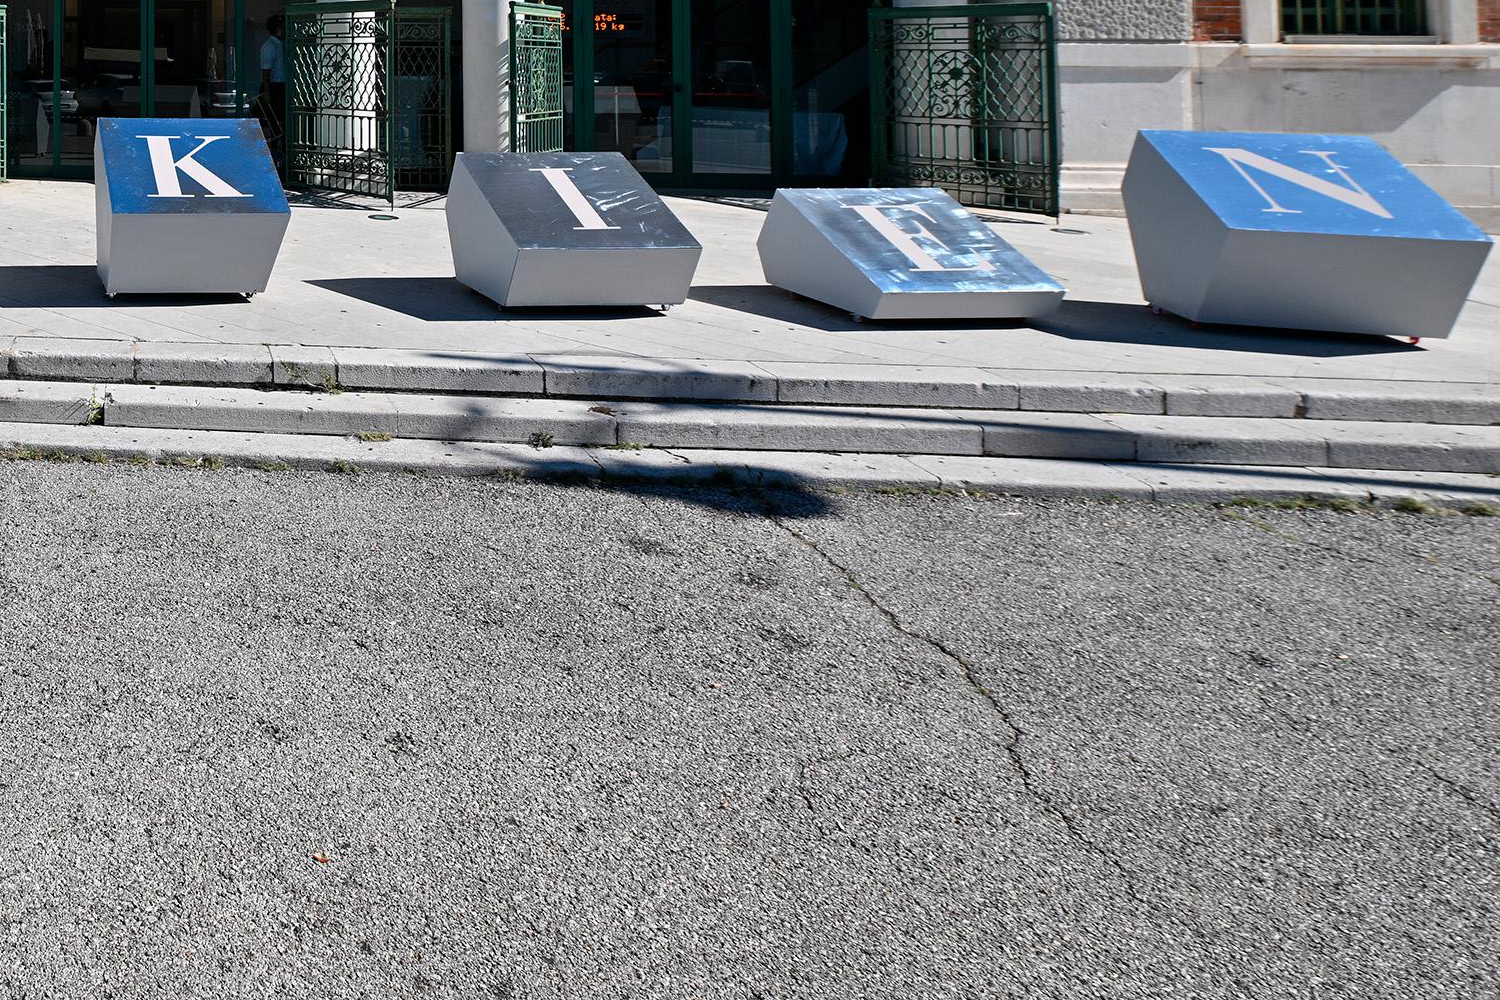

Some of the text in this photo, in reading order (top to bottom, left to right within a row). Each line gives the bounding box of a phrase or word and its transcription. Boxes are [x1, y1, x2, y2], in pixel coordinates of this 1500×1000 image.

[136, 135, 254, 198] K
[528, 167, 621, 230] I
[1203, 146, 1393, 219] N
[842, 204, 995, 272] E
